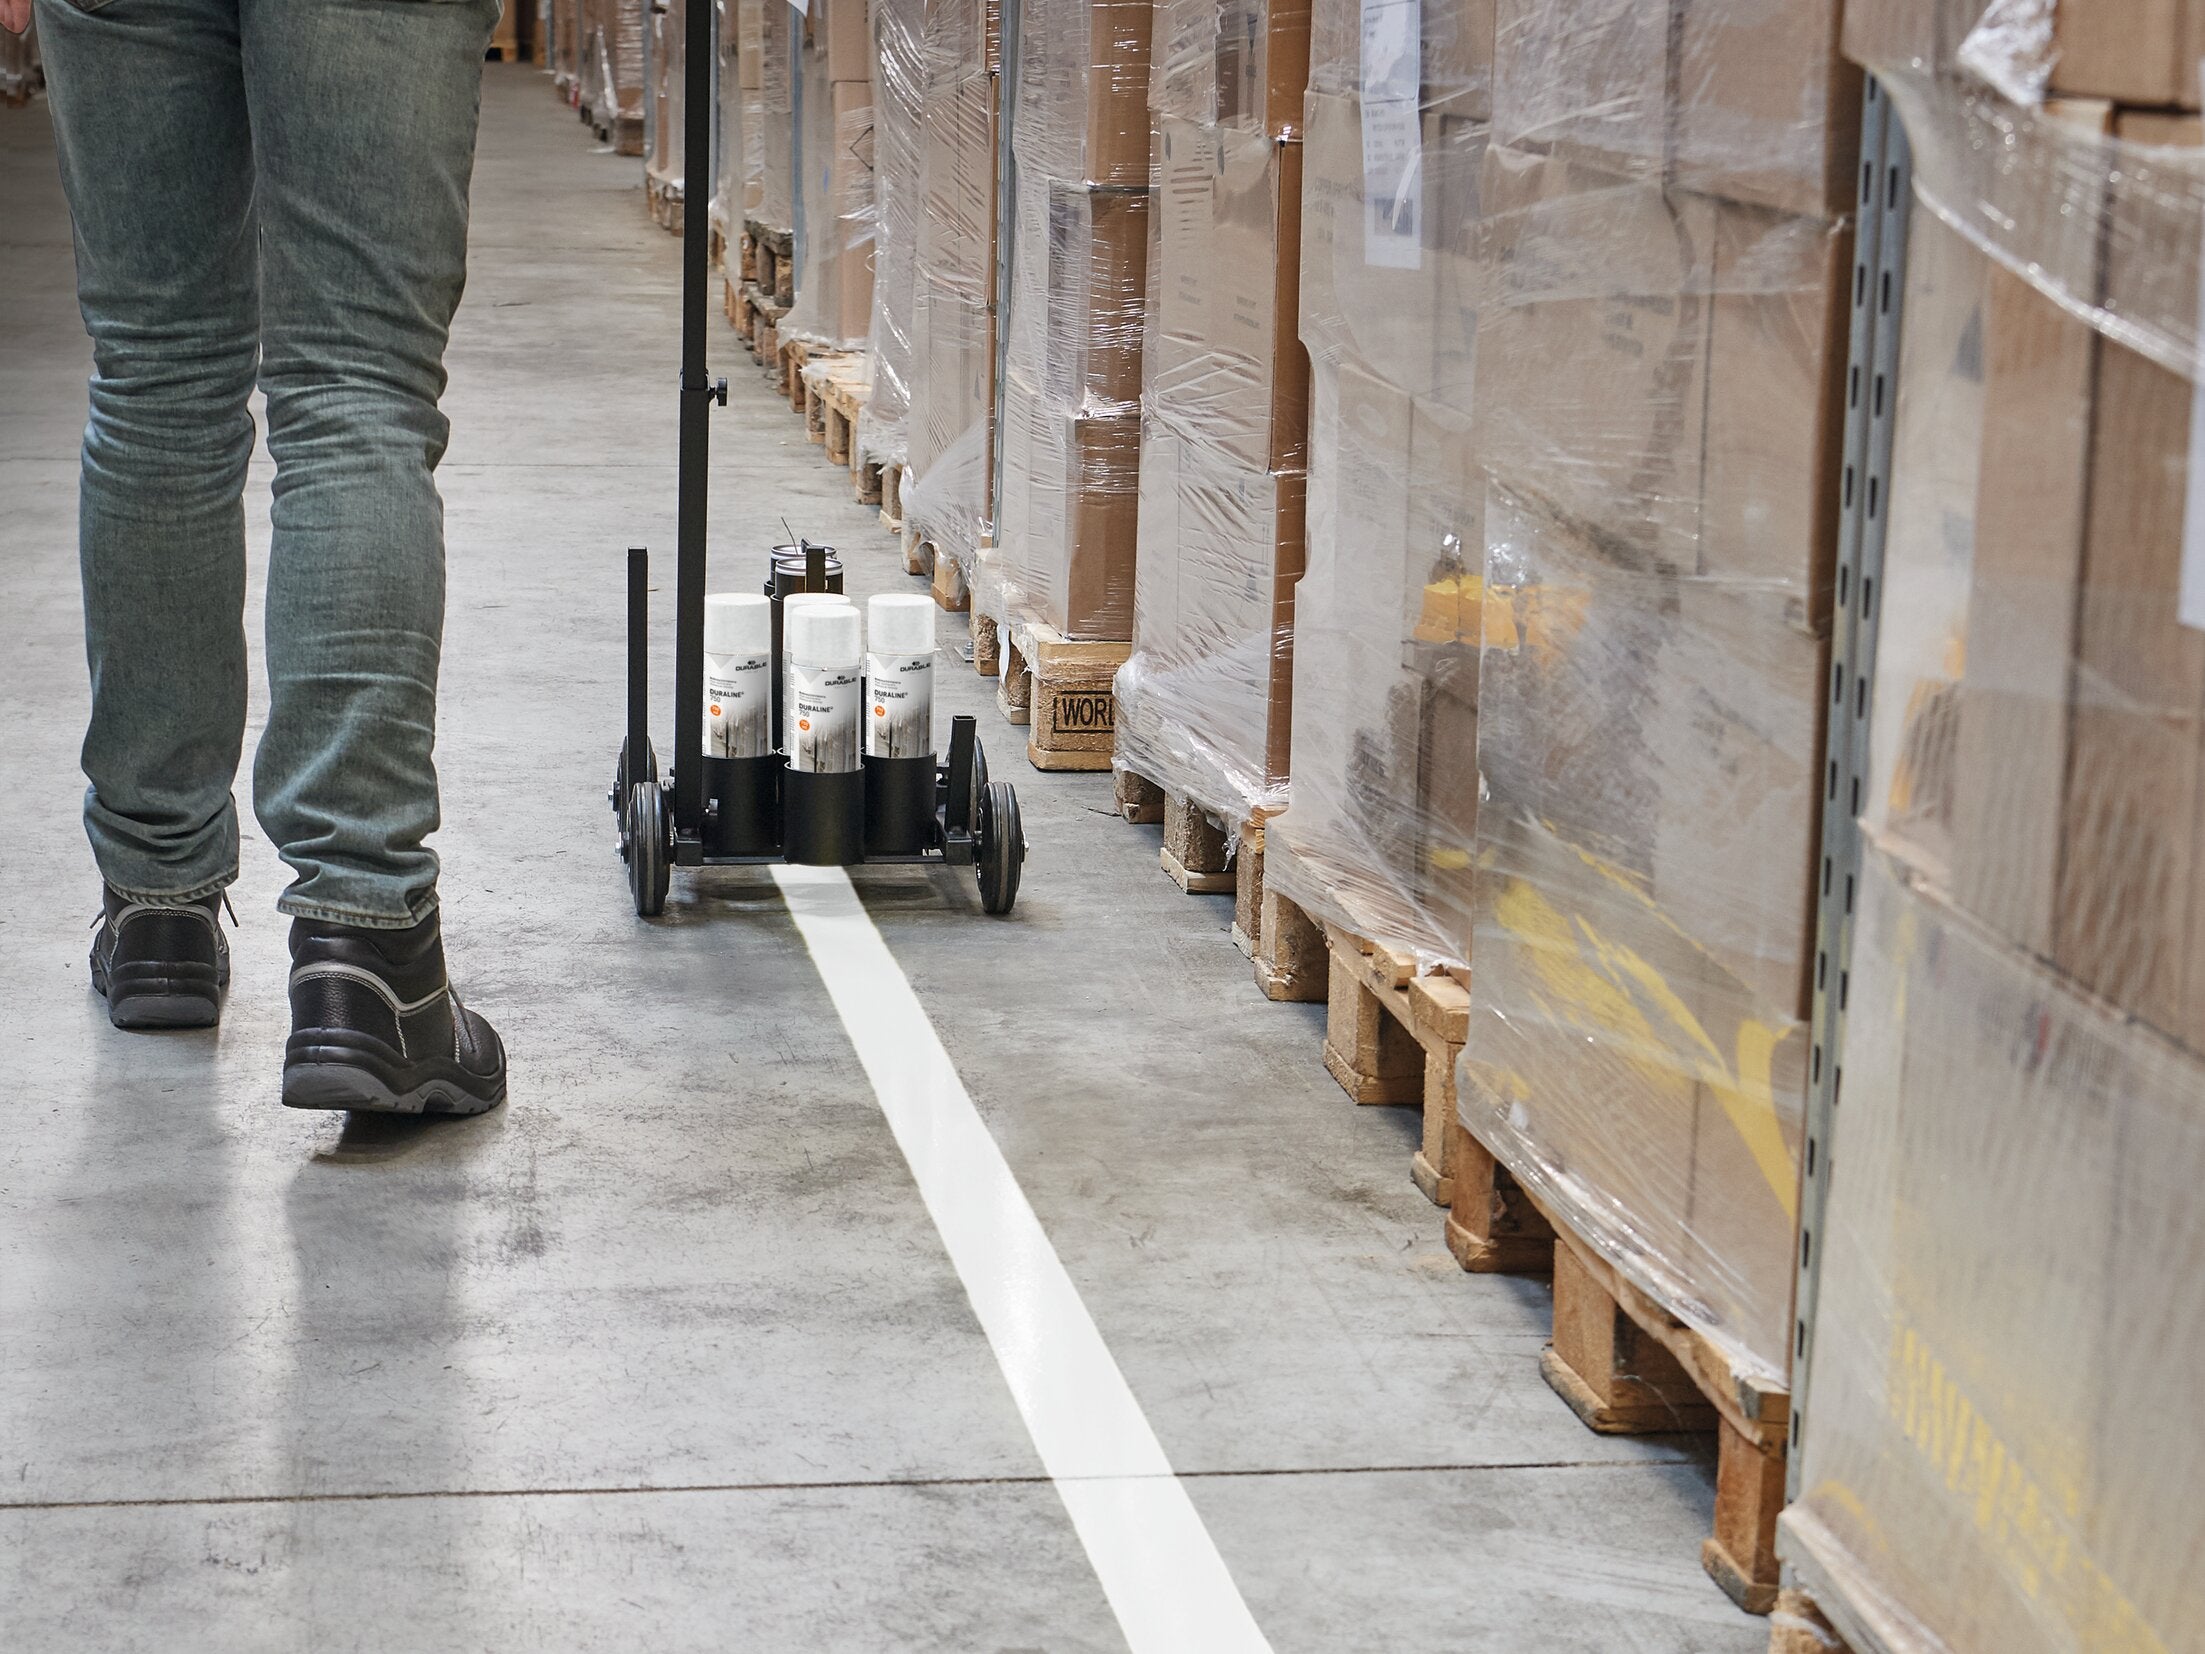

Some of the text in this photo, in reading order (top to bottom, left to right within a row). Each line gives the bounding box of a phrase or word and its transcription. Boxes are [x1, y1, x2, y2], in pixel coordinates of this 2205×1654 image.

[735, 661, 767, 671] DURABLE
[899, 662, 931, 672] DURABLE
[825, 677, 857, 686] DURABLE
